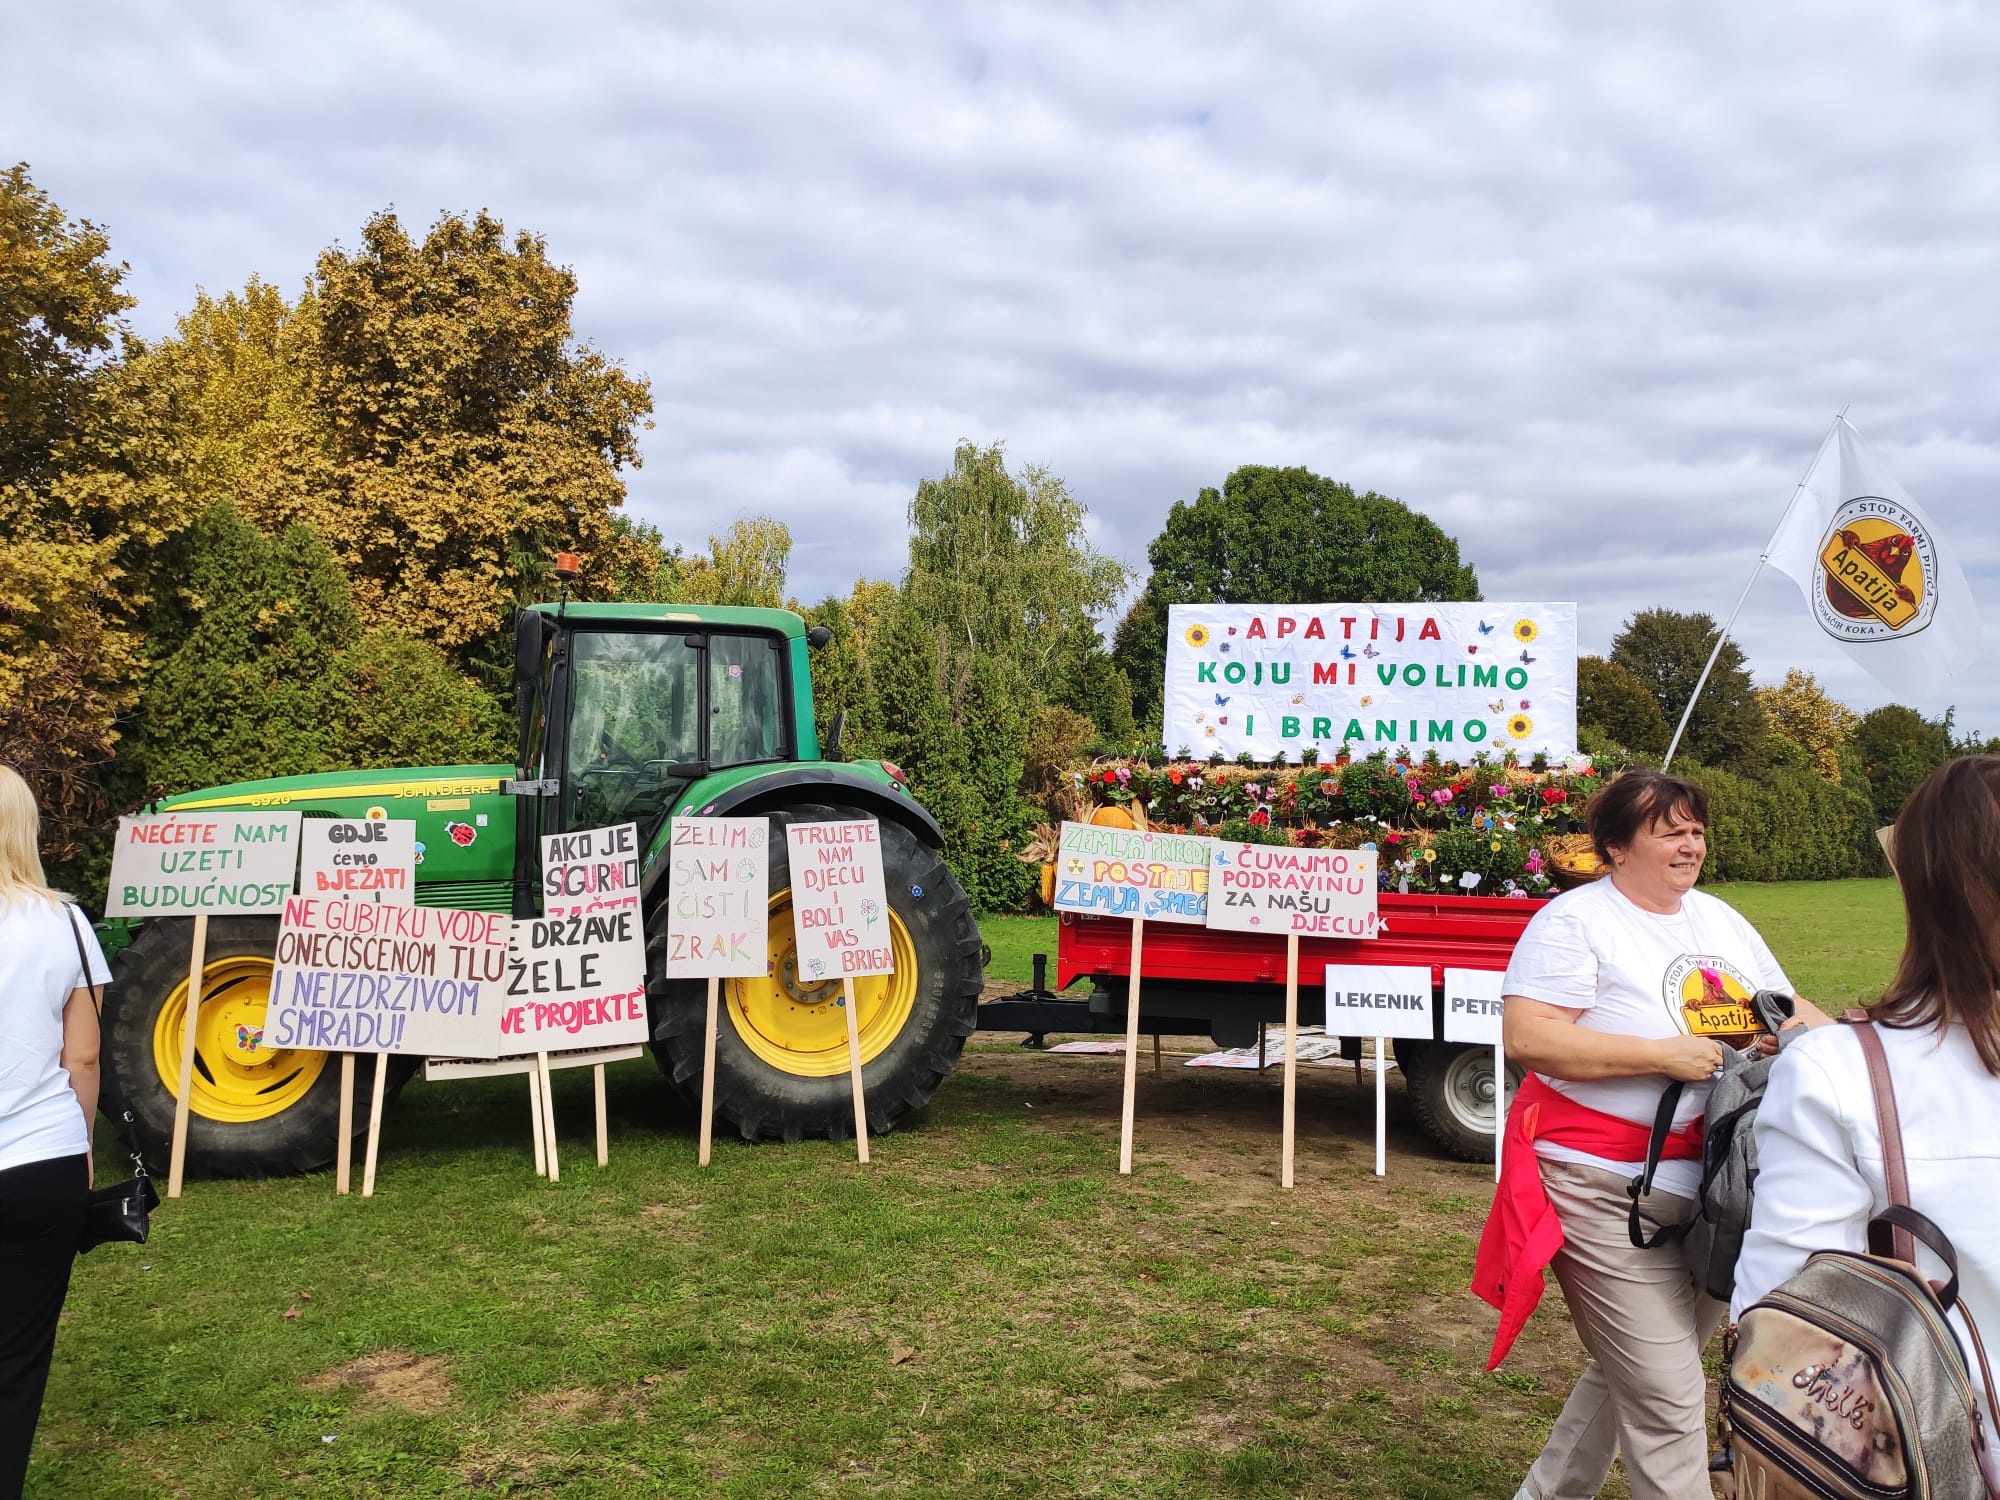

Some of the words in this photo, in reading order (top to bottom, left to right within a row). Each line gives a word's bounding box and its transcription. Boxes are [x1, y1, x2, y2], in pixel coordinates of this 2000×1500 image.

[1859, 502, 1897, 516] STOP
[1900, 513, 1927, 550] FARMI
[1832, 549, 1898, 612] Apatija
[1246, 617, 1442, 642] APATIJA
[1844, 625, 1875, 634] KOKA
[1197, 661, 1291, 686] KOJU
[1313, 662, 1356, 685] MI
[1377, 663, 1529, 690] VOLIMO
[1245, 715, 1254, 736] I
[1281, 716, 1487, 742] BRANIMO
[250, 795, 292, 807] 6920
[394, 784, 438, 799] JOHN
[440, 784, 492, 796] DEERE
[130, 815, 218, 845] NEĆETE
[233, 824, 288, 843] NAM
[328, 822, 389, 843] GDJE
[673, 823, 766, 849] ŽELIMO
[791, 823, 878, 845] TRUJETE
[548, 833, 593, 862] AKO
[600, 826, 634, 857] JE
[817, 845, 853, 865] NAM
[1061, 826, 1146, 862] ZEMLJA
[160, 850, 243, 874] UZETI
[674, 857, 757, 887] SAMO
[1237, 844, 1348, 875] ČUVAJMO
[316, 864, 406, 891] BJEŽATI
[545, 859, 639, 897] SIGURNO
[803, 866, 864, 893] DJECU
[1092, 860, 1210, 893] POSTAJE
[1223, 870, 1364, 895] PODRAVINU
[122, 876, 291, 908] BUDUĆNOST
[833, 891, 839, 905] I
[1055, 880, 1140, 914] ZEMLJA
[1224, 891, 1256, 908] ZA
[1267, 890, 1331, 914] NAŠU
[284, 899, 320, 928] NE
[325, 901, 428, 939] GUBITKU
[531, 911, 633, 949] DRŽAVE
[801, 906, 844, 929] BOLI
[1291, 912, 1376, 935] DJECU!
[669, 932, 752, 962] ZRAK
[824, 928, 859, 949] VAS
[278, 931, 436, 977] ONEČIŠĆENOM
[449, 945, 506, 982] TLU
[841, 948, 894, 973] BRIGA
[506, 953, 602, 996] ŽELE
[1669, 965, 1685, 988] STOP
[272, 970, 283, 1006] I
[292, 971, 480, 1016] NEIZDRŽIVOM
[1335, 991, 1424, 1011] LEKENIK
[1451, 997, 1504, 1017] PETR
[1699, 1008, 1758, 1030] Apatija
[275, 1008, 407, 1051] SMRADU!
